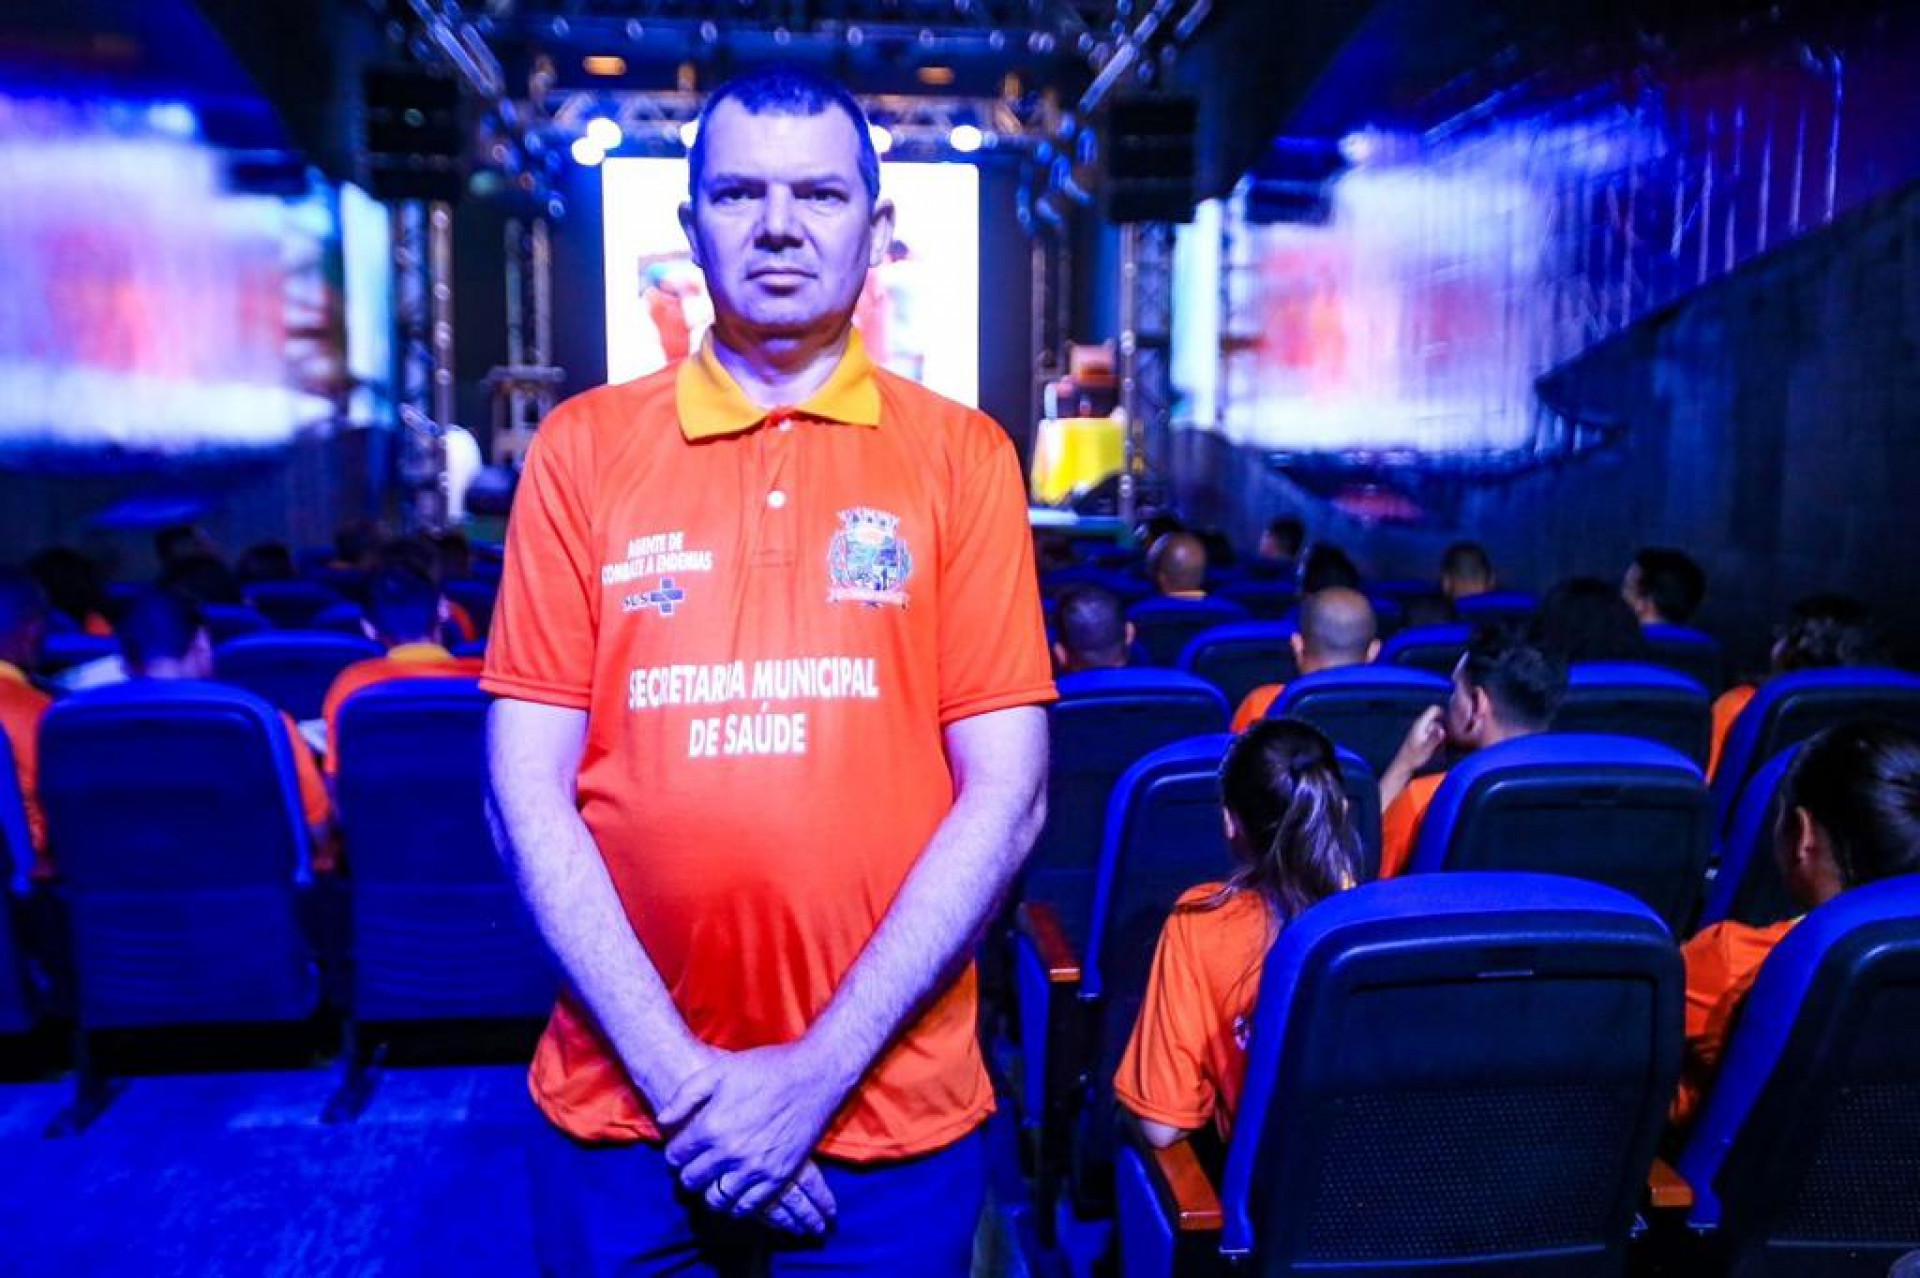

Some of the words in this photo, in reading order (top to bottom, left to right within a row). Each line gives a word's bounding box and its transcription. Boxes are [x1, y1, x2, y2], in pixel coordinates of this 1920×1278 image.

[669, 531, 684, 552] DE
[629, 660, 746, 709] SECRETARIA
[752, 656, 880, 700] MUNICIPAL
[689, 717, 721, 758] DE
[724, 700, 807, 755] SAÚDE
